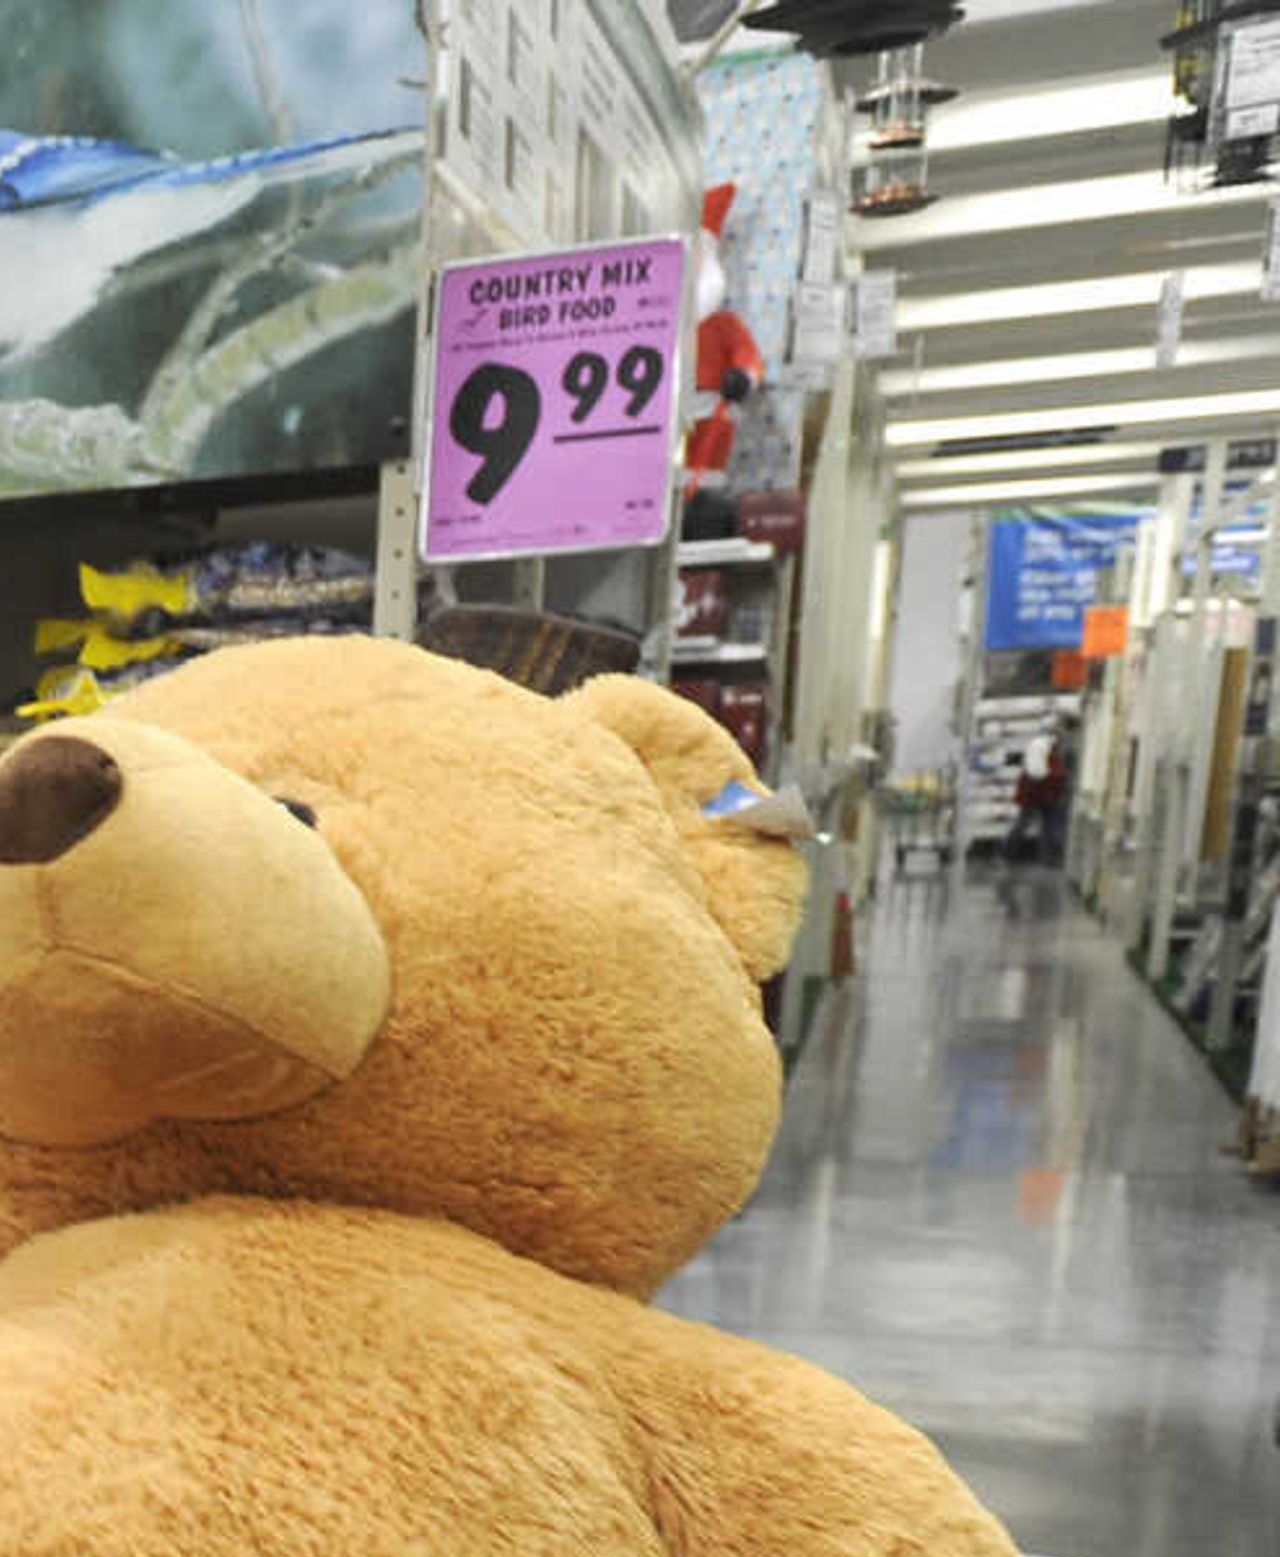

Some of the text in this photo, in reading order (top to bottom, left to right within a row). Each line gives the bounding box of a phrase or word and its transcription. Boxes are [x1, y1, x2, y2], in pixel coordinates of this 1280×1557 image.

[470, 257, 652, 305] COUNTRY MIX
[499, 296, 616, 331] BIRD FOOD
[450, 345, 664, 507] 9 99
